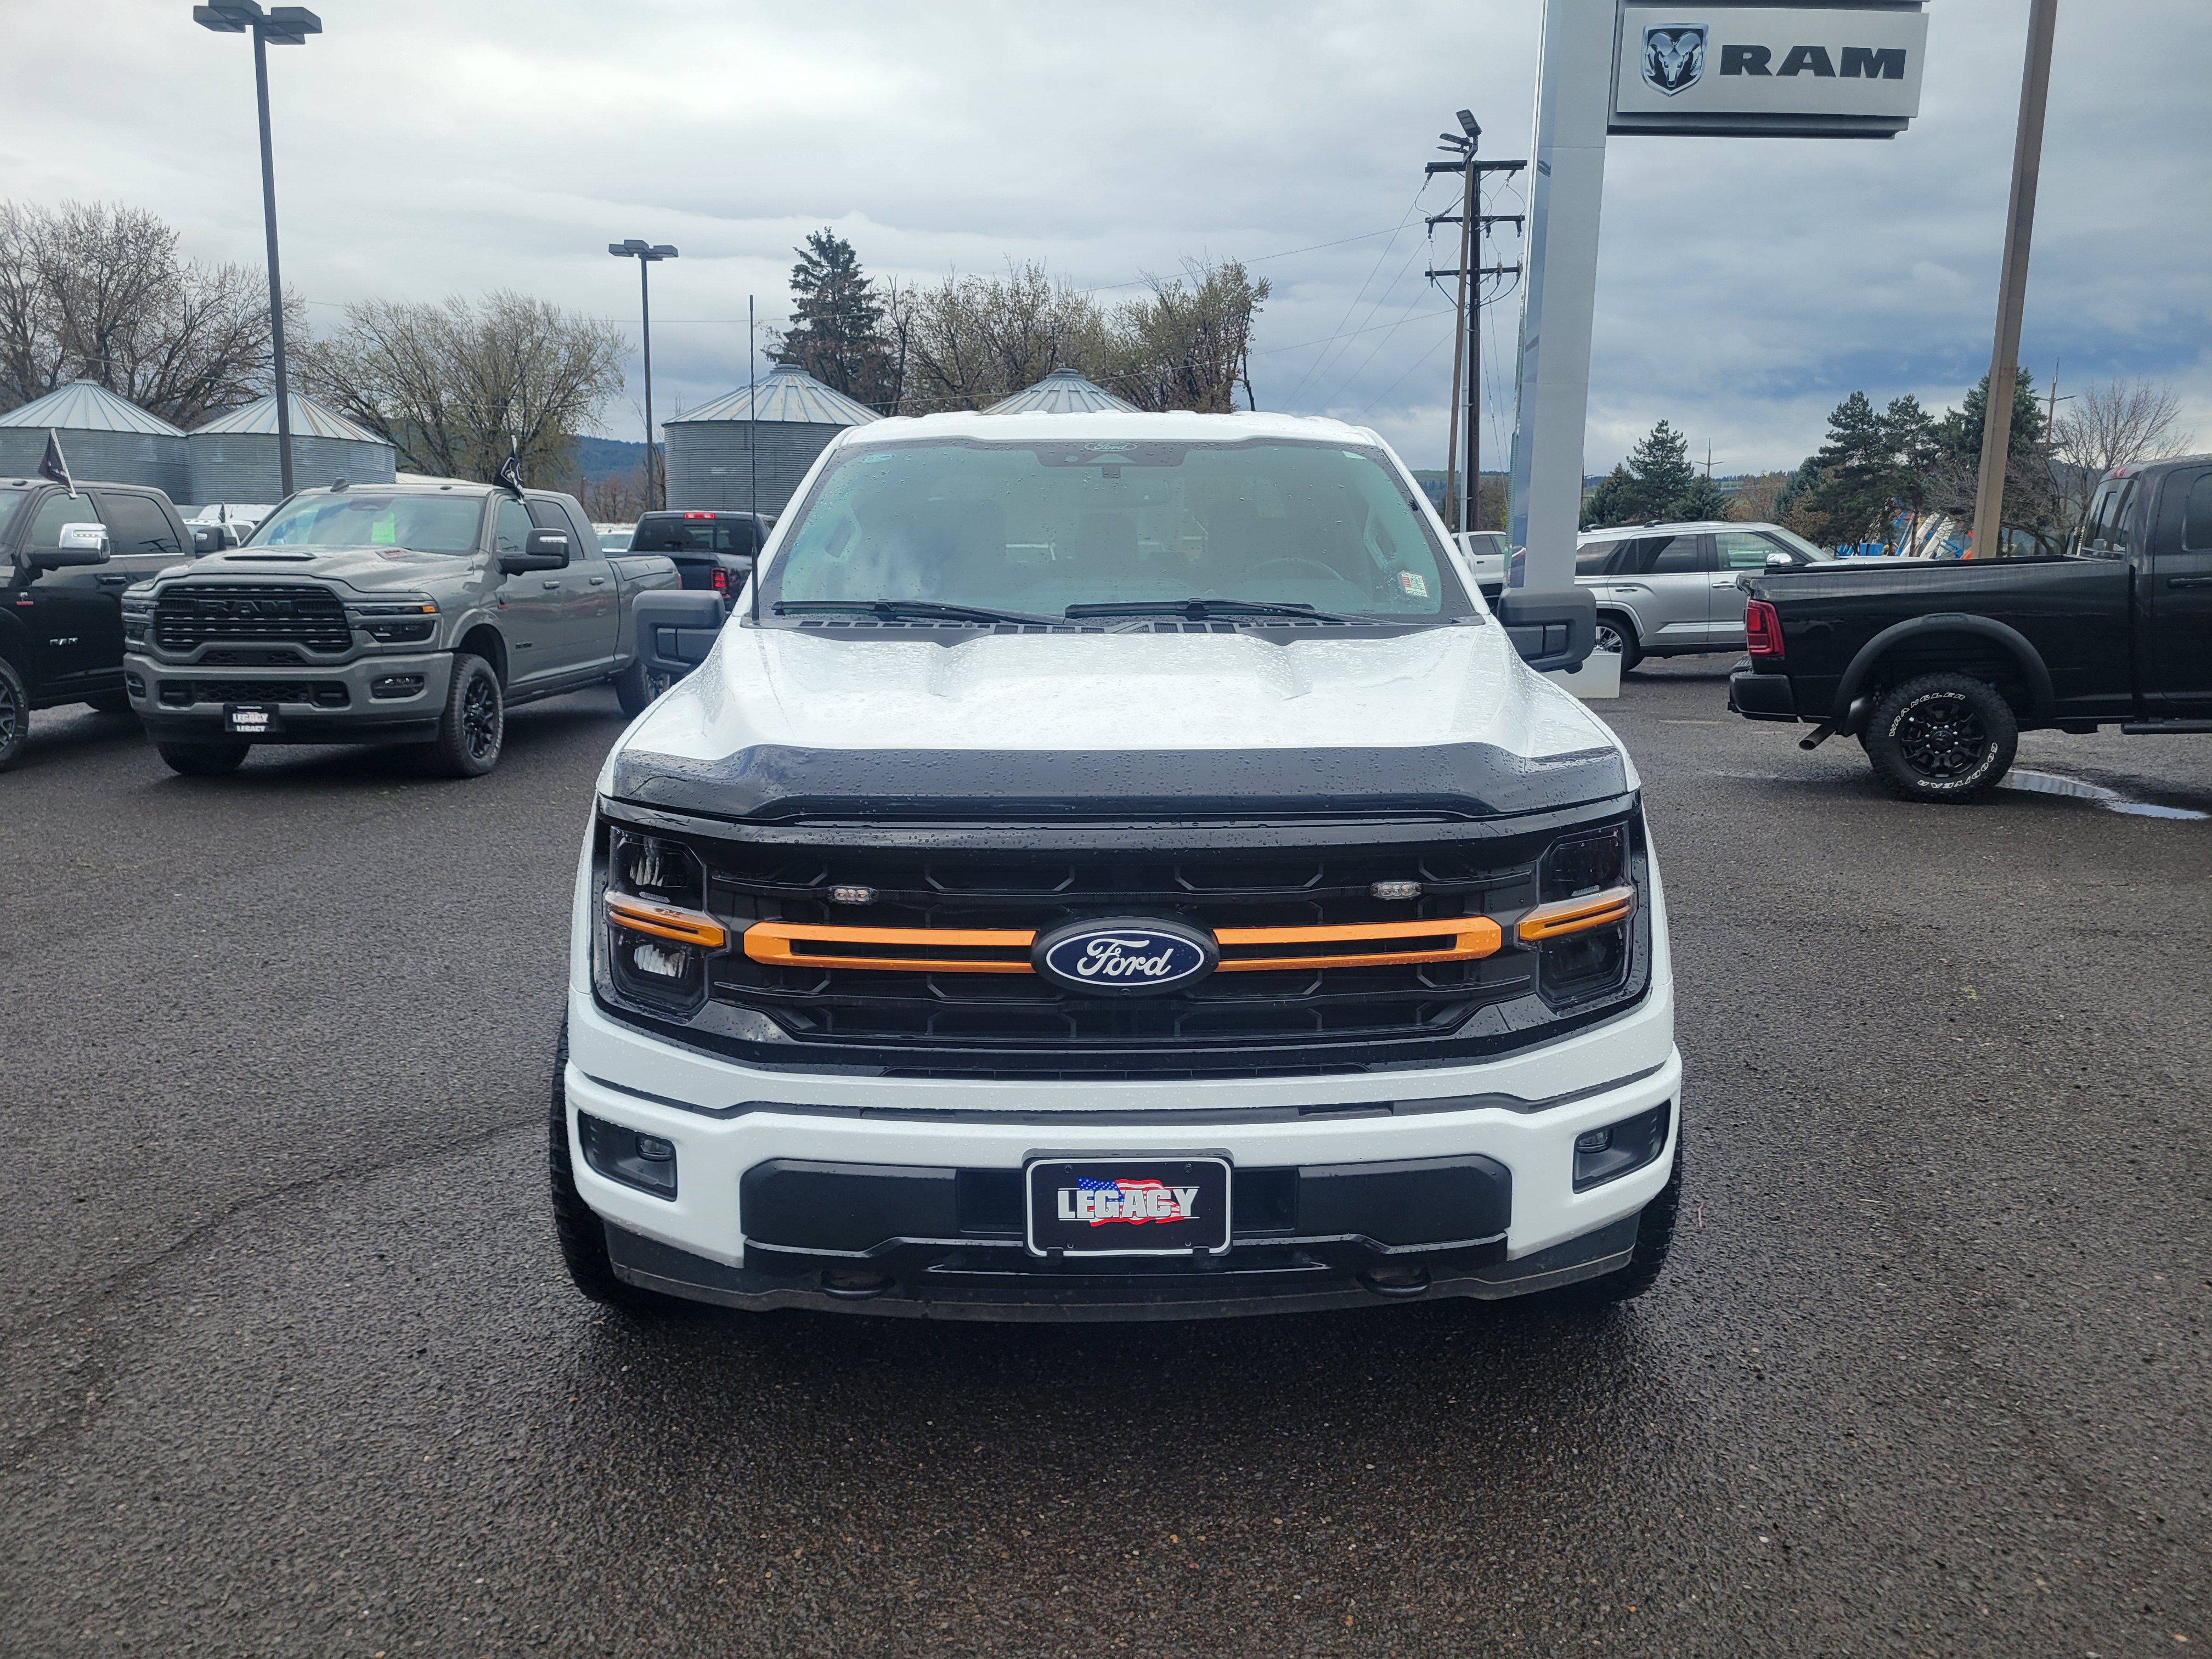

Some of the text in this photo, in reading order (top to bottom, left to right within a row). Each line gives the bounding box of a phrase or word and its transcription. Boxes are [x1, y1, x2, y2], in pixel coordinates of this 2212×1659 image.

[1719, 45, 1906, 80] RAM
[198, 600, 293, 613] RAM
[232, 713, 269, 724] LEGACY
[1888, 692, 1966, 737] WRANGLER
[1917, 742, 1998, 789] GOODYEAR
[1076, 937, 1174, 977] Ford
[1057, 1188, 1198, 1219] LEGACY
